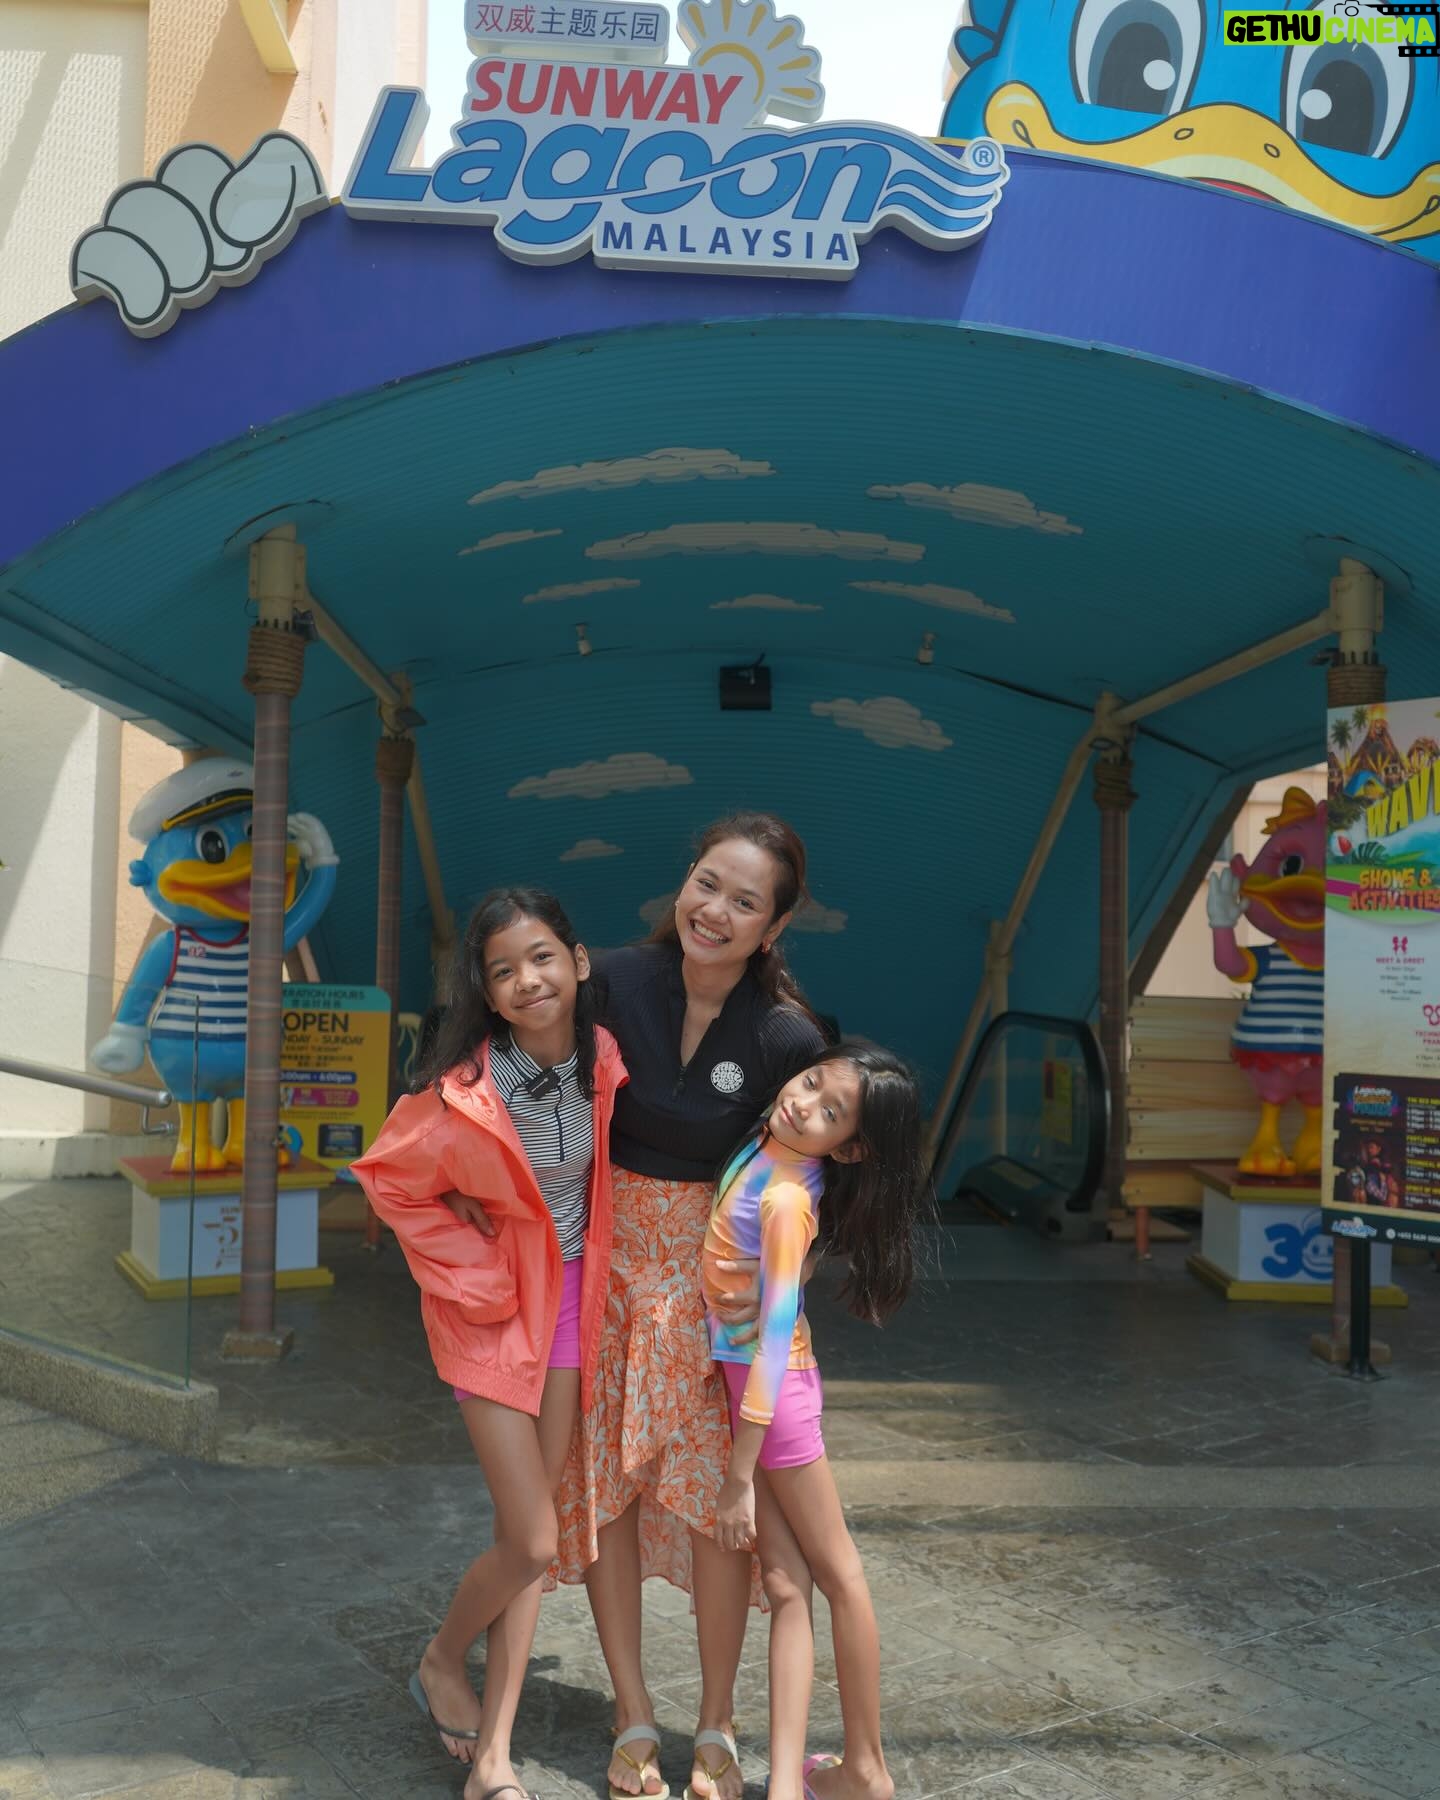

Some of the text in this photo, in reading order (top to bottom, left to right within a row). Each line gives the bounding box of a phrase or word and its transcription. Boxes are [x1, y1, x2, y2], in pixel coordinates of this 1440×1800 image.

[474, 3, 660, 42] 双威主题乐园
[470, 60, 744, 125] SUNWAY
[349, 90, 893, 245] Lagoon
[601, 219, 851, 262] MALAYSIA
[1360, 867, 1416, 889] SHOWS
[283, 1011, 350, 1033] OPEN
